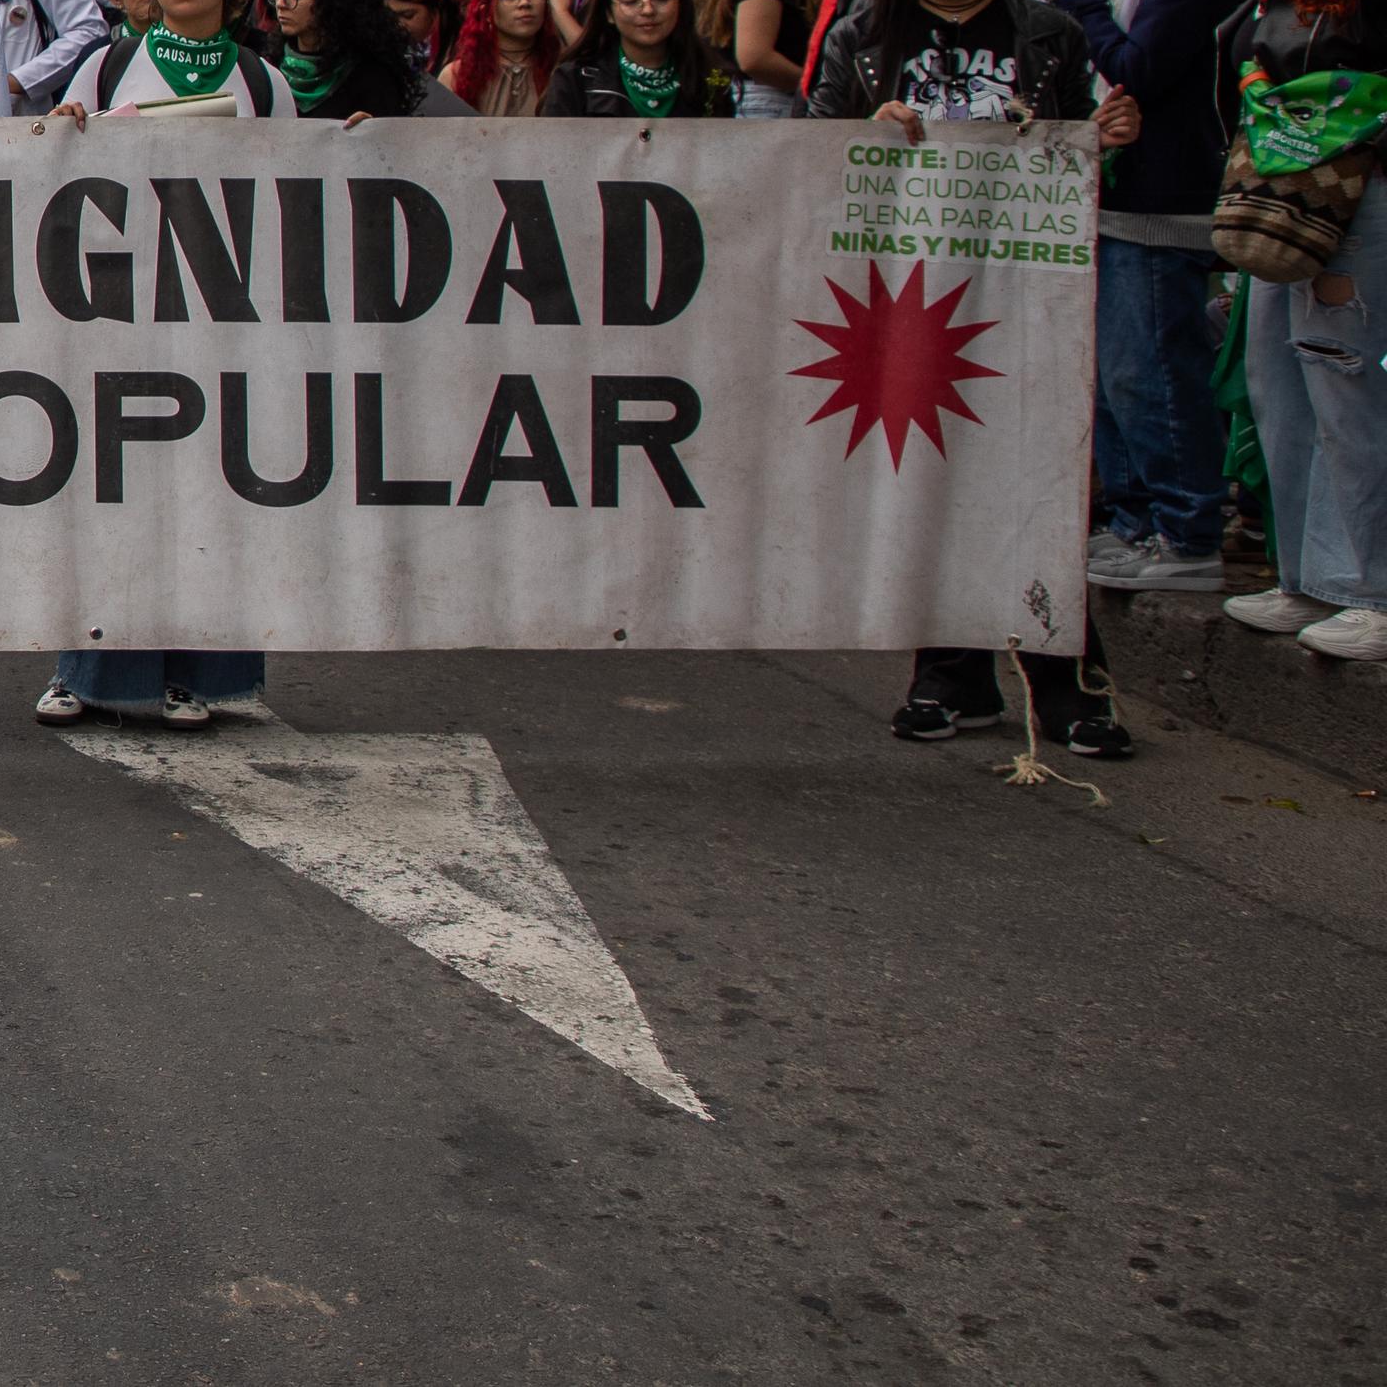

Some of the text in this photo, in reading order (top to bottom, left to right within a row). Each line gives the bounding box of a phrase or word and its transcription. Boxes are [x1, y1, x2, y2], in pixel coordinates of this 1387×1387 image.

[156, 46, 192, 65] CAUSA
[848, 145, 947, 169] CORTE:
[956, 150, 1019, 173] DIGA
[1061, 156, 1083, 176] A
[845, 173, 1083, 206] UNA CIUDADANÍA
[846, 203, 1077, 235] PLENA PARA LAS
[831, 227, 1091, 266] NIÑAS Y MUJERES
